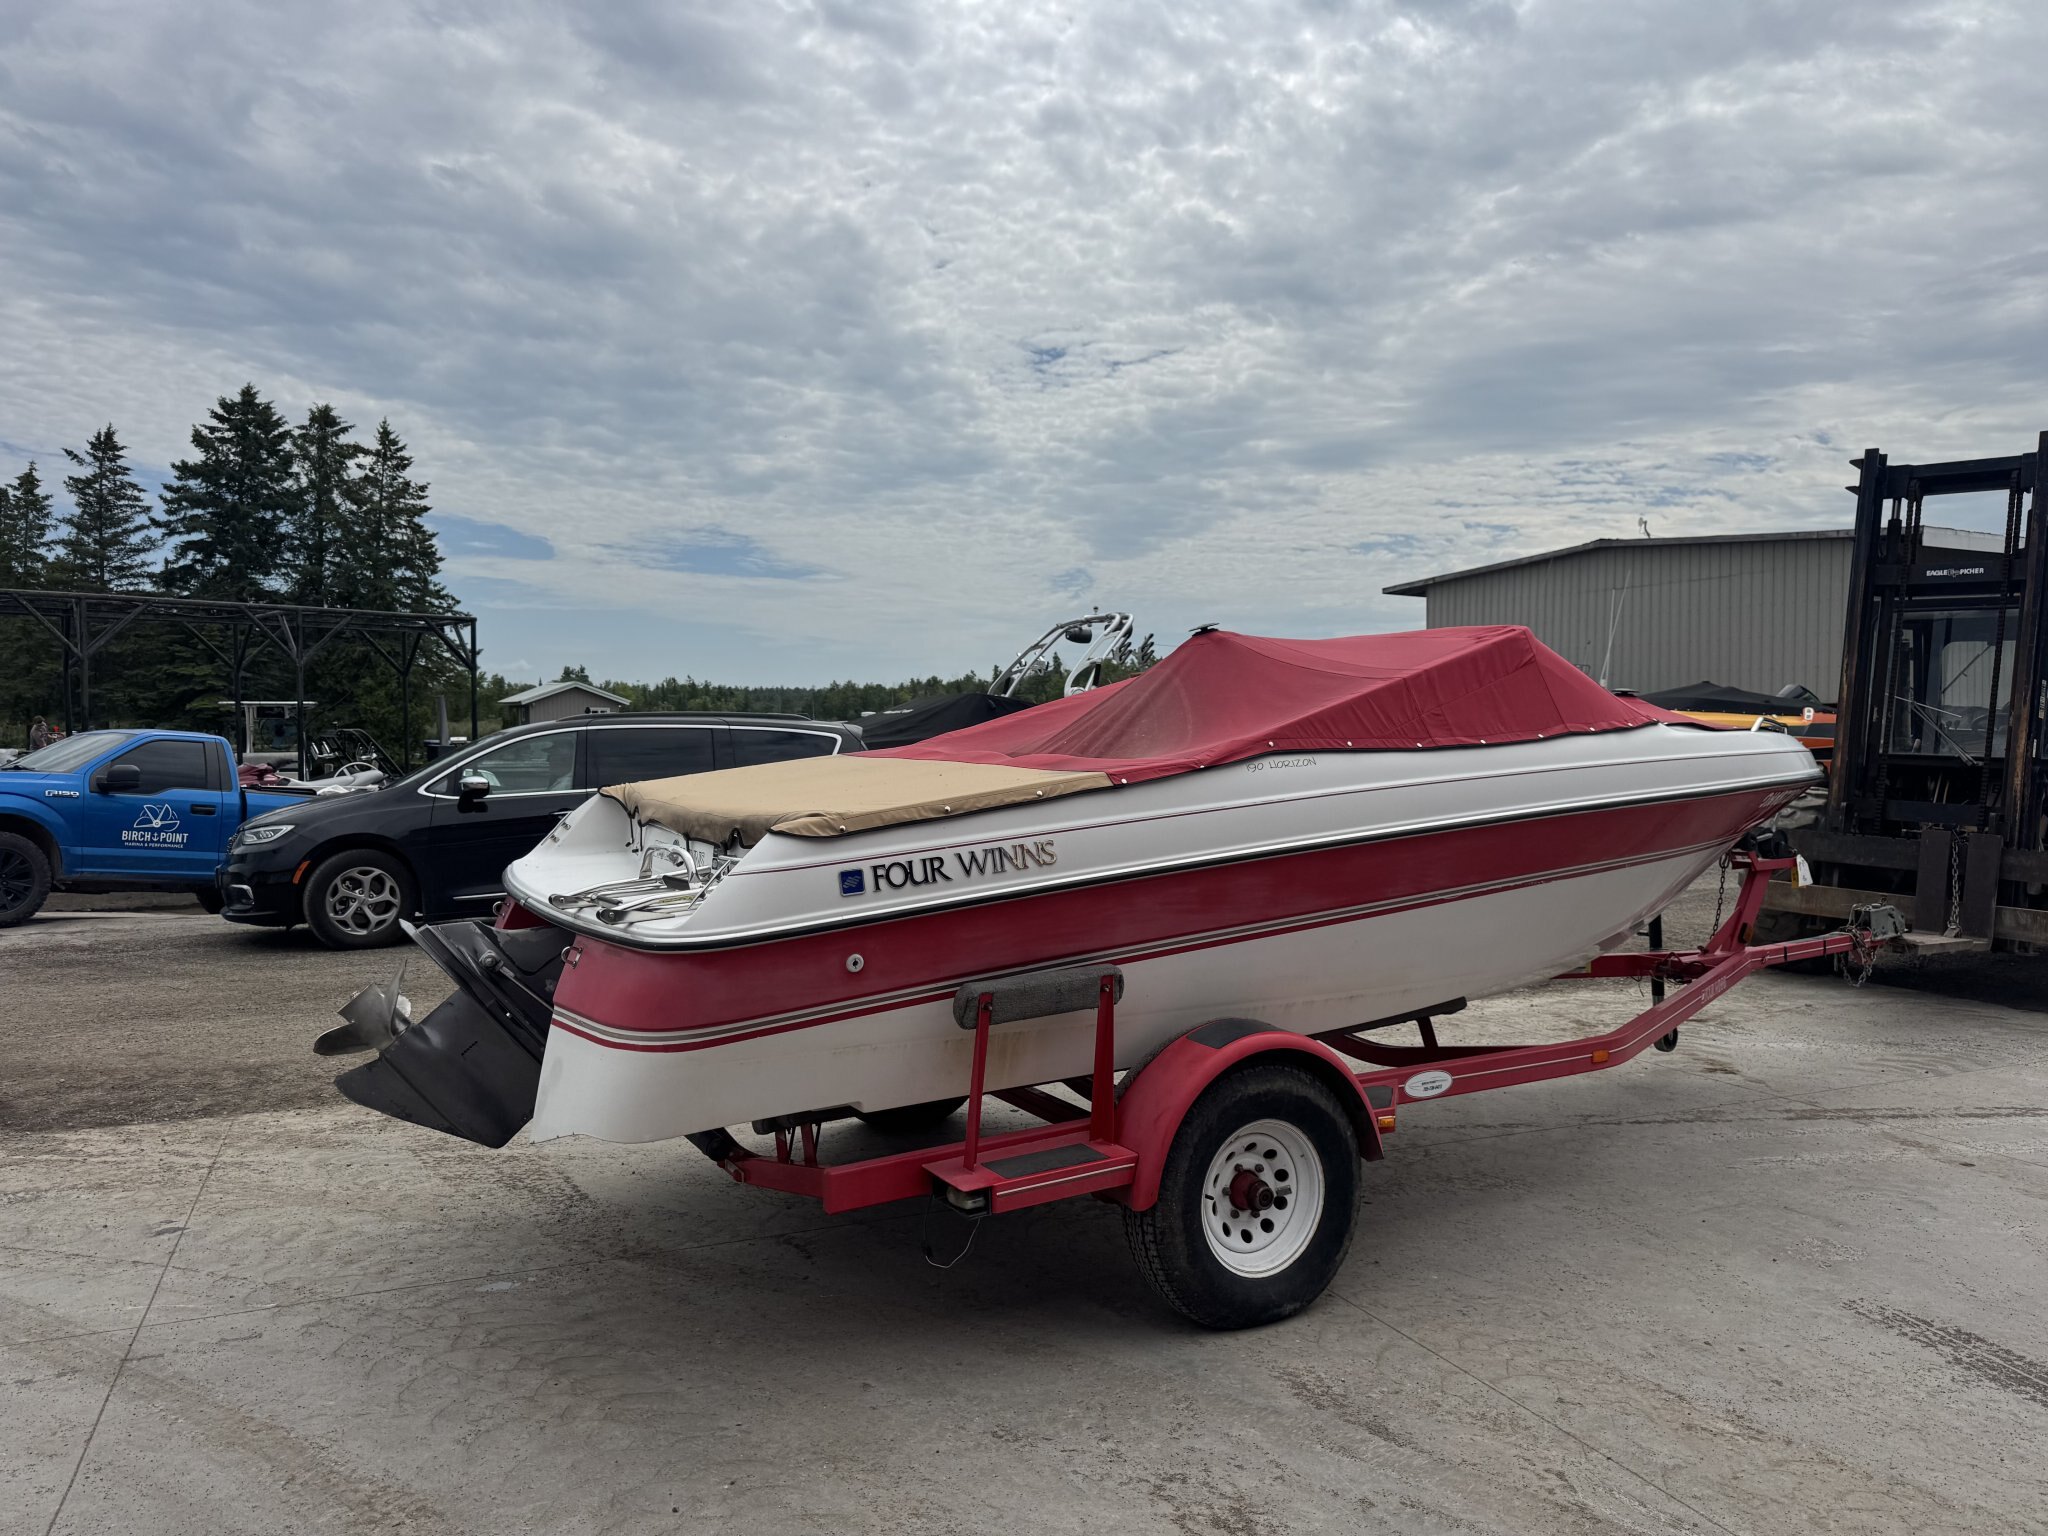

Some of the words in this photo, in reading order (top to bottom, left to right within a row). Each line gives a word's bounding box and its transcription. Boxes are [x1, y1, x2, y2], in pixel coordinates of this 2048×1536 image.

[121, 830, 151, 842] BIRCH
[160, 832, 189, 844] POINT
[871, 856, 952, 892] FOUR
[954, 840, 1057, 877] WINNS
